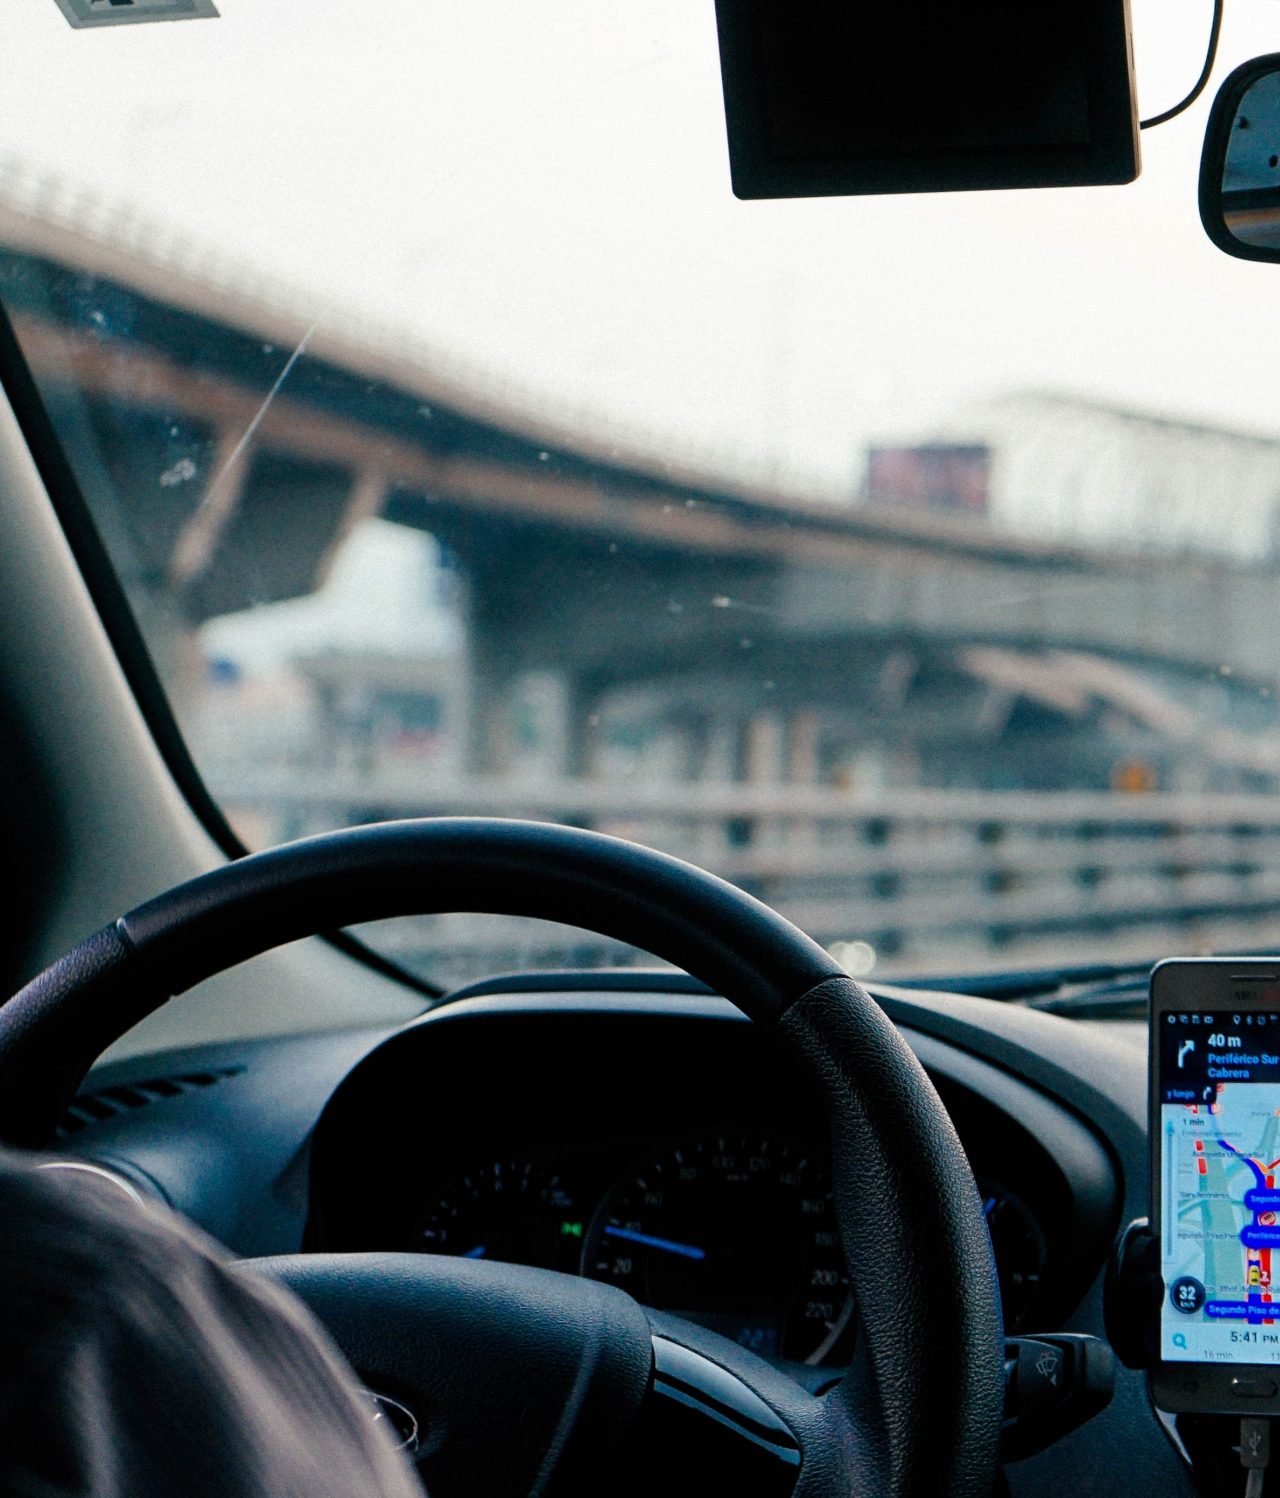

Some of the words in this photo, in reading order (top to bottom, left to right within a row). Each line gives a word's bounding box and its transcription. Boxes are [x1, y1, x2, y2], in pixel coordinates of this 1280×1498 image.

[1208, 1034, 1225, 1047] 40
[1228, 1037, 1242, 1047] m
[1208, 1053, 1259, 1065] Periférico
[1261, 1053, 1279, 1065] Sur
[1208, 1067, 1250, 1078] Cabrera
[613, 1257, 632, 1275] 20
[1179, 1285, 1196, 1300] 32
[1209, 1305, 1246, 1315] Segundo
[1248, 1306, 1266, 1315] Piso
[1231, 1331, 1258, 1343] 5:41
[1263, 1335, 1279, 1344] PM
[1204, 1350, 1215, 1359] 16
[1216, 1350, 1234, 1359] min
[1271, 1352, 1279, 1361] 11
